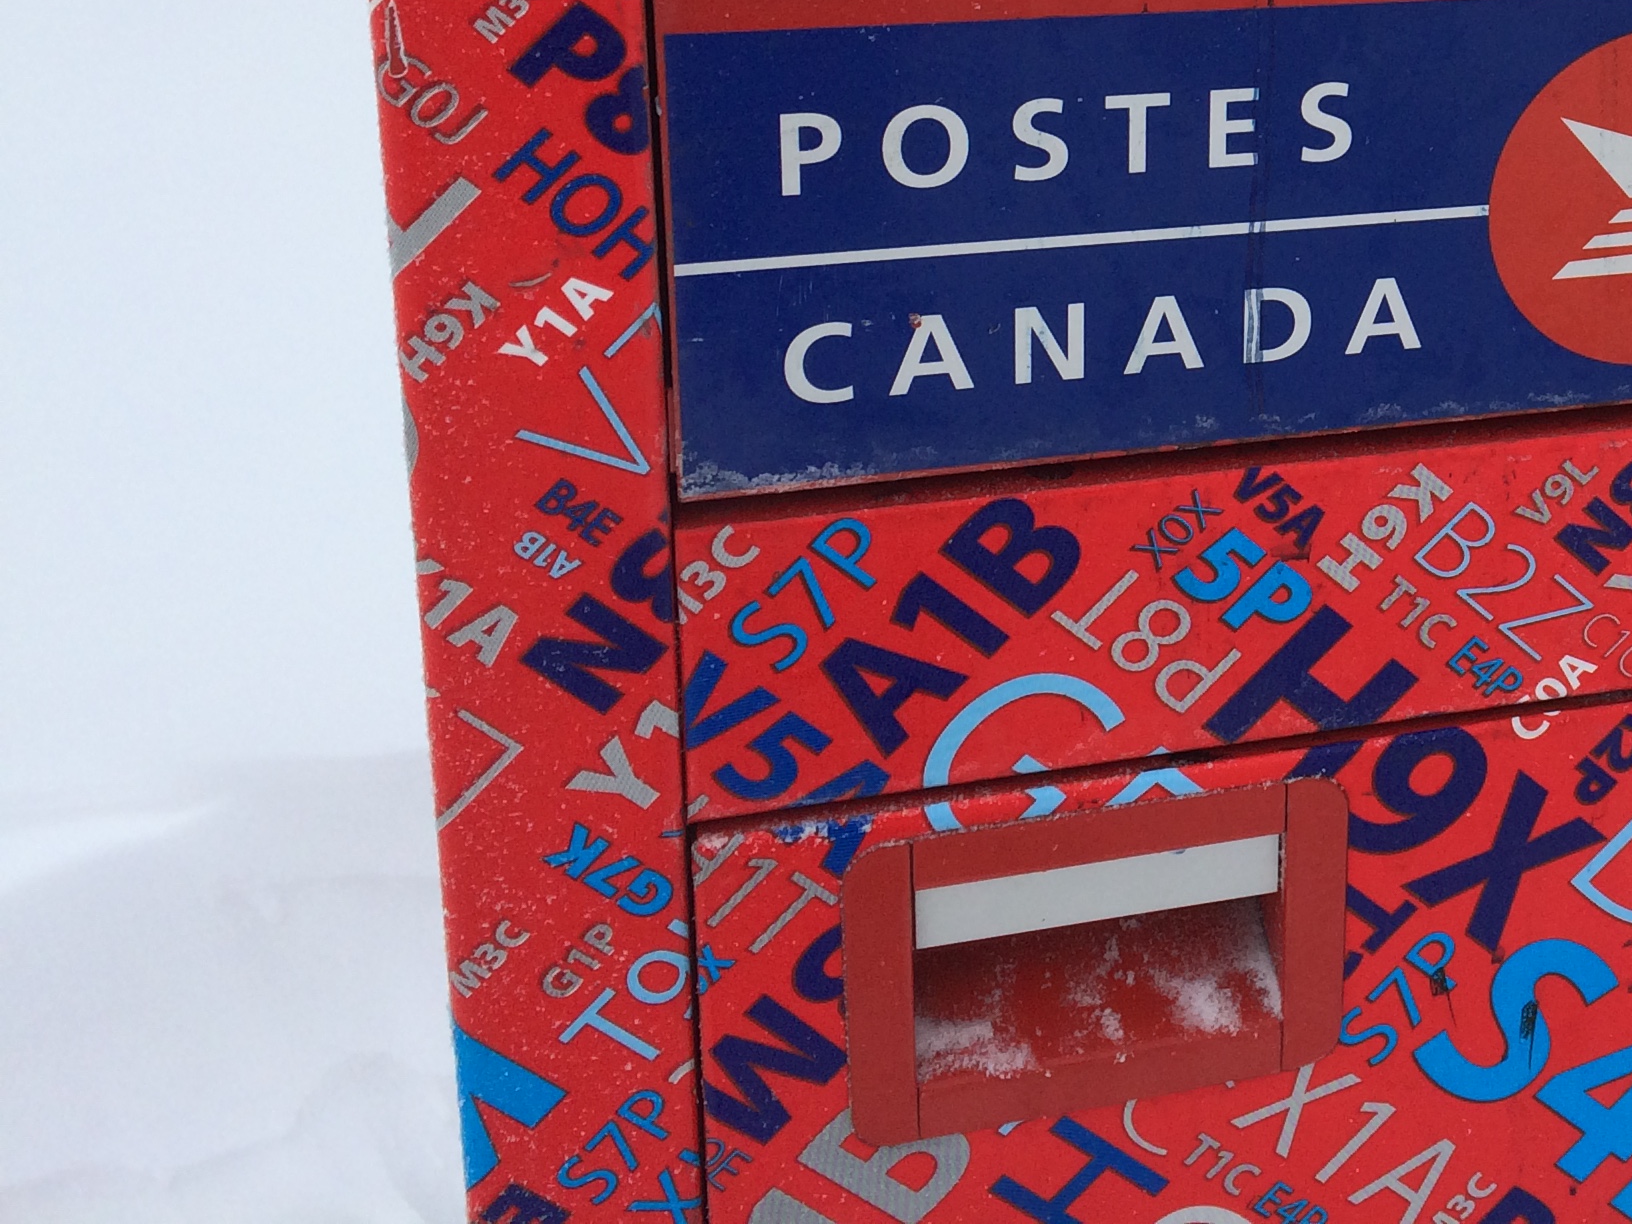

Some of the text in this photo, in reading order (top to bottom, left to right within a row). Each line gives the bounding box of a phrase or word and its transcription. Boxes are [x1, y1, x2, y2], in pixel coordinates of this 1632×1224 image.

[779, 81, 1353, 197] POSTES
[494, 276, 614, 367] Y1A
[783, 277, 1423, 404] CANADA
[533, 477, 622, 547] B4E
[1514, 459, 1600, 526] V9L
[729, 517, 877, 673] S7P
[818, 496, 1082, 759] A1B
[1379, 575, 1458, 649] T1C
[1413, 500, 1595, 661] B2Z
[1447, 635, 1523, 696] E4P
[449, 919, 531, 999] M3C
[541, 924, 616, 999] G1P
[1338, 931, 1458, 1067] S7P
[555, 1089, 671, 1205] S7P
[1183, 1132, 1263, 1197] T1C
[1229, 1062, 1457, 1224] X1A
